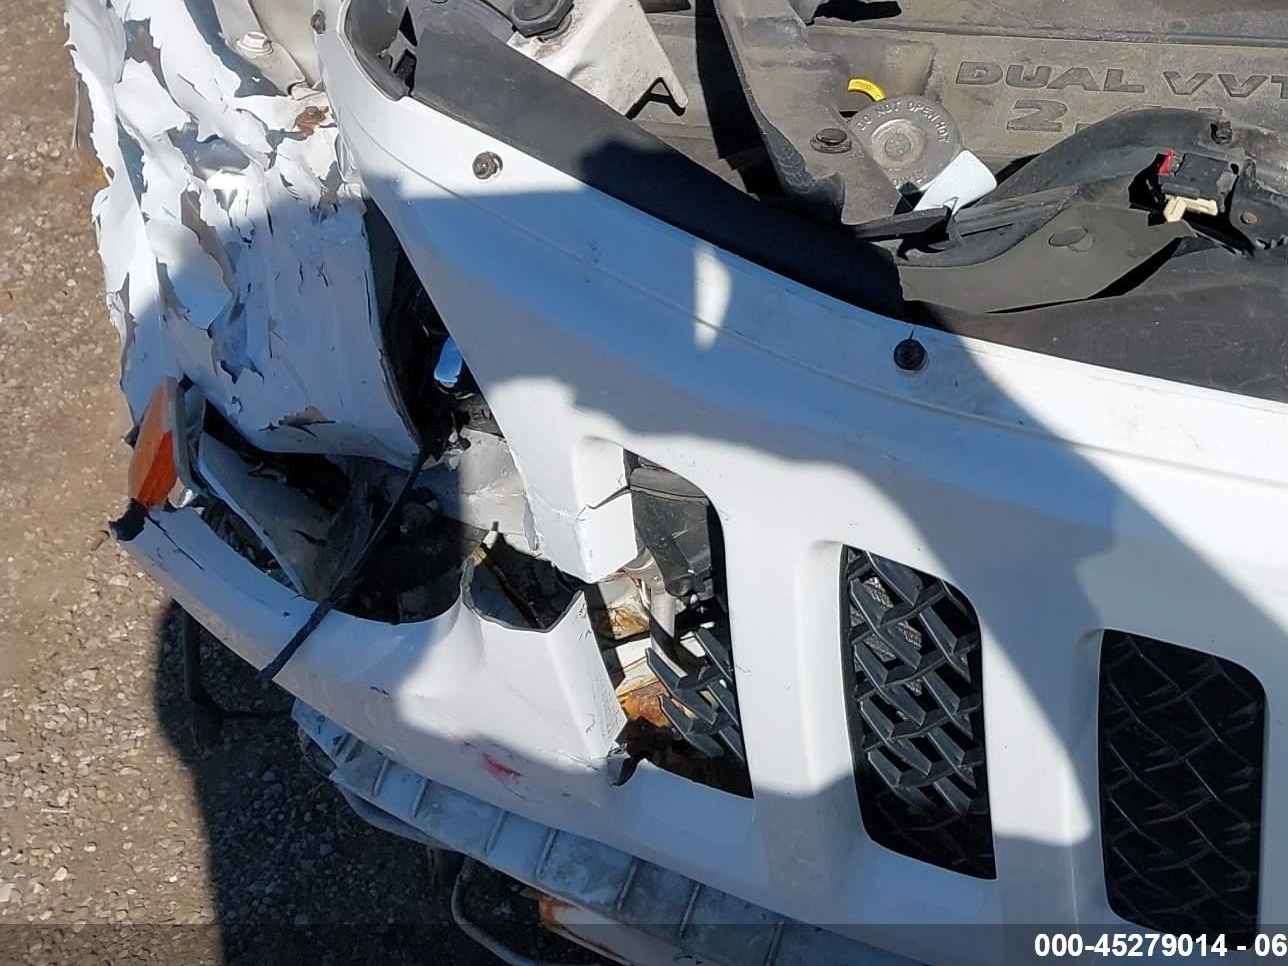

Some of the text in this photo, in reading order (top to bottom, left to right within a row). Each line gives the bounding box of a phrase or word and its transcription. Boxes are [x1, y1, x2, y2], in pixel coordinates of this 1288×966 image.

[955, 61, 1145, 94] DUAL
[878, 101, 901, 118] NOT
[907, 101, 940, 124] OPEN
